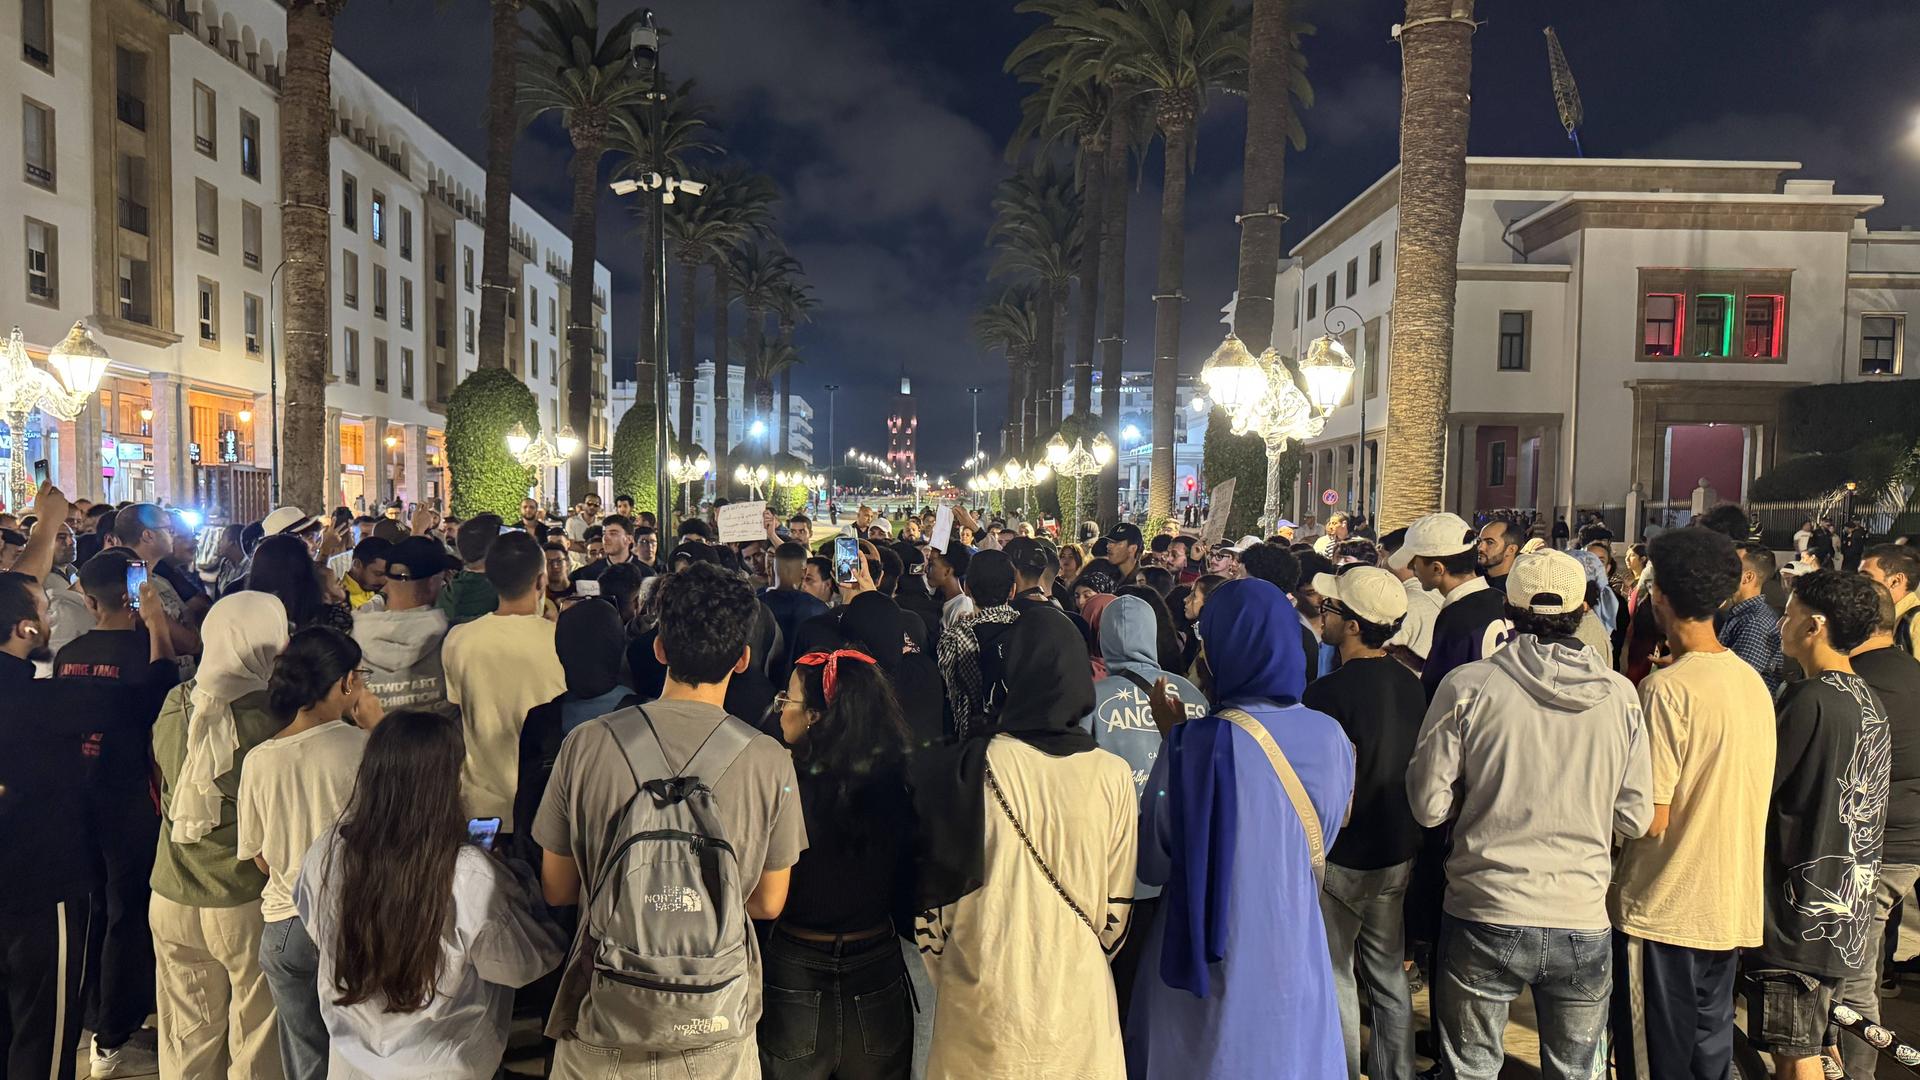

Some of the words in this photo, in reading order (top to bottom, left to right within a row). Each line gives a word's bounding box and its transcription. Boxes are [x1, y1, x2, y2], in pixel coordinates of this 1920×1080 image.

[411, 677, 438, 690] ART
[1133, 683, 1180, 705] LS
[1107, 703, 1206, 733] ANGES
[645, 894, 682, 903] NORH
